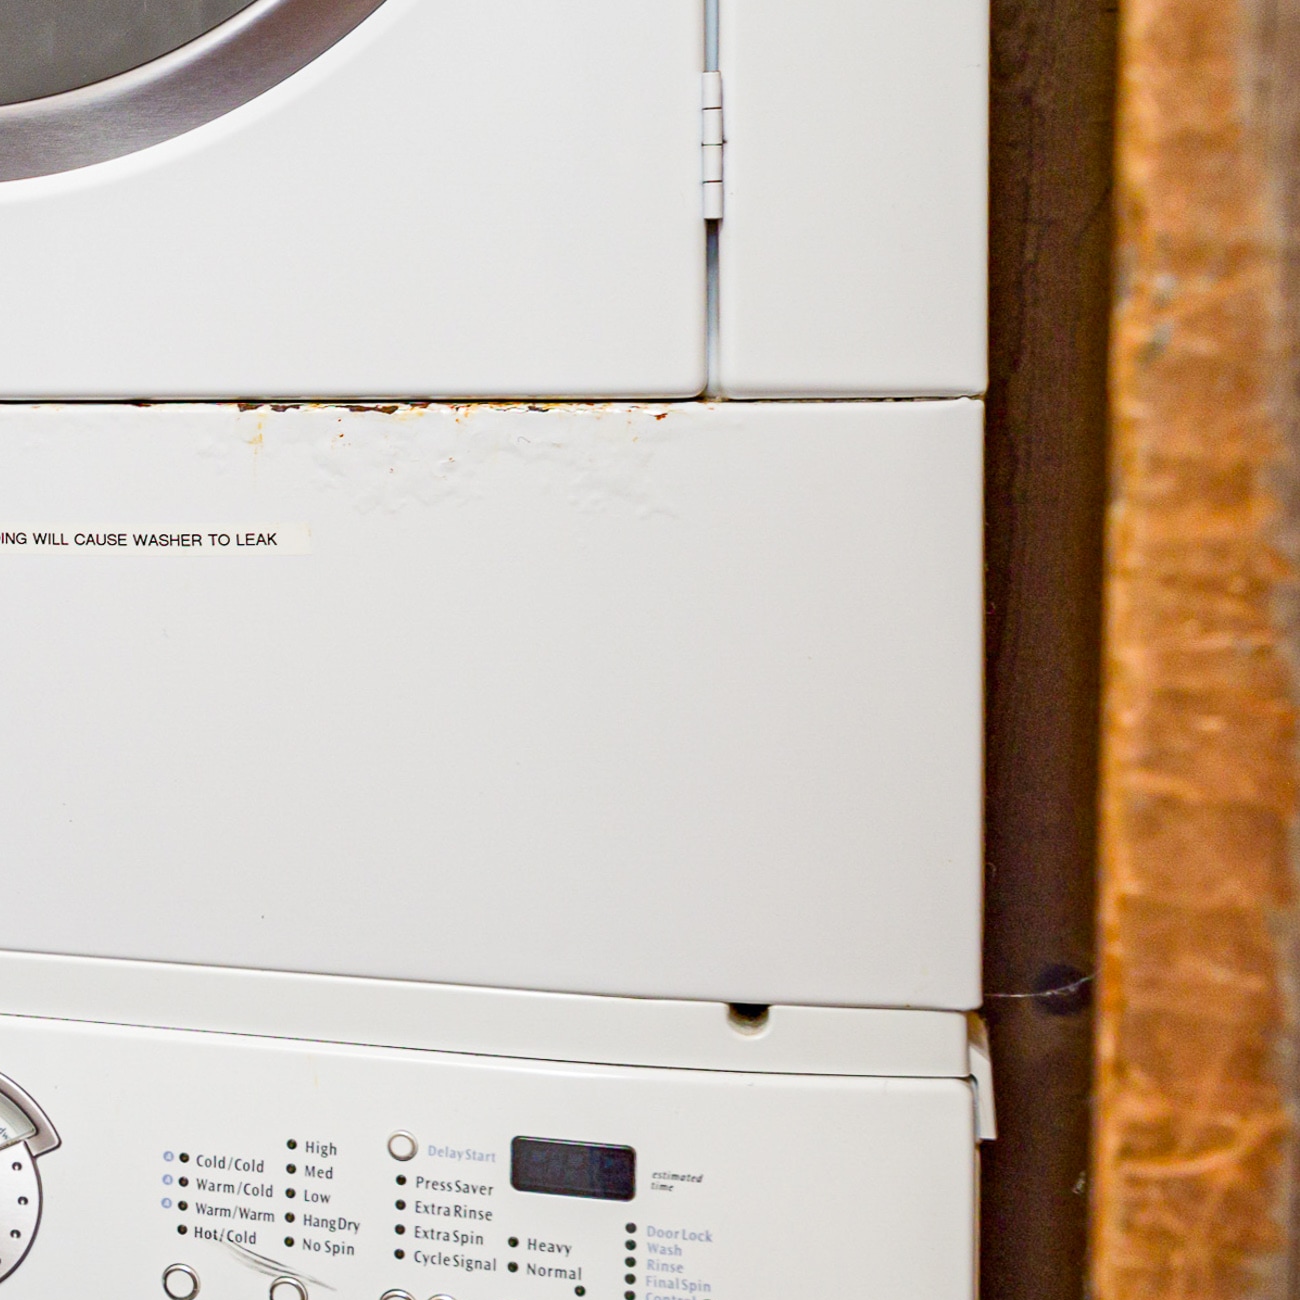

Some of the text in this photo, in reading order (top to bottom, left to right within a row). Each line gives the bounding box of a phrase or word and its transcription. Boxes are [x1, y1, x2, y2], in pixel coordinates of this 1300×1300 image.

[32, 532, 70, 546] WILL
[74, 533, 128, 547] CAUSE
[132, 533, 203, 547] WASHER
[207, 533, 231, 547] TO
[236, 532, 278, 547] LEAK
[304, 1140, 338, 1158] High
[427, 1144, 496, 1163] Delay Start
[195, 1154, 265, 1174] Cold/Cold
[304, 1165, 334, 1180] Med
[415, 1175, 495, 1197] Press Saver
[651, 1171, 704, 1183] estimated
[195, 1177, 274, 1198] Warm/Cold
[303, 1189, 332, 1204] Low
[650, 1182, 674, 1192] time
[195, 1202, 275, 1223] Warm/Warm
[414, 1200, 493, 1221] Extra Rinse
[303, 1213, 361, 1235] Hang Dry
[194, 1225, 257, 1245] Hot/Cold
[414, 1225, 484, 1247] Extra Spin
[646, 1225, 713, 1243] Door Lock
[302, 1237, 355, 1257] No Spin
[526, 1237, 573, 1257] Heavy
[647, 1242, 683, 1257] Wash
[413, 1250, 497, 1272] Cycle Signal
[646, 1258, 684, 1274] Rinse
[526, 1262, 582, 1281] Normal
[645, 1275, 712, 1293] Final Spin
